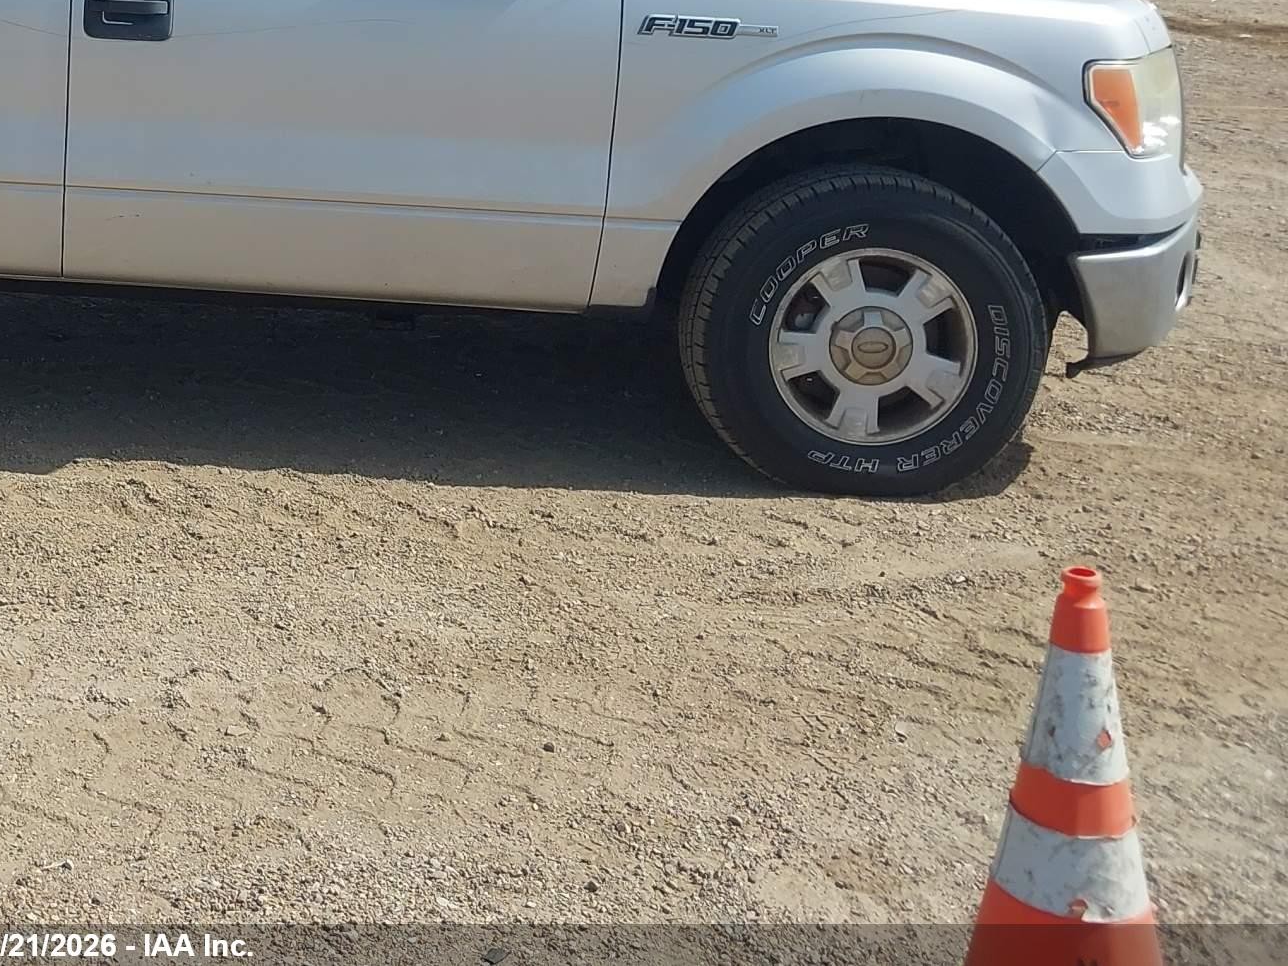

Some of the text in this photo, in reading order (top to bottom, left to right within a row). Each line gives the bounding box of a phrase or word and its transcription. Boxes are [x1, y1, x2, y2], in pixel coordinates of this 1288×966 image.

[638, 14, 740, 39] F-150
[749, 223, 871, 327] COOPER
[807, 304, 1011, 473] DISCOVERER HTP
